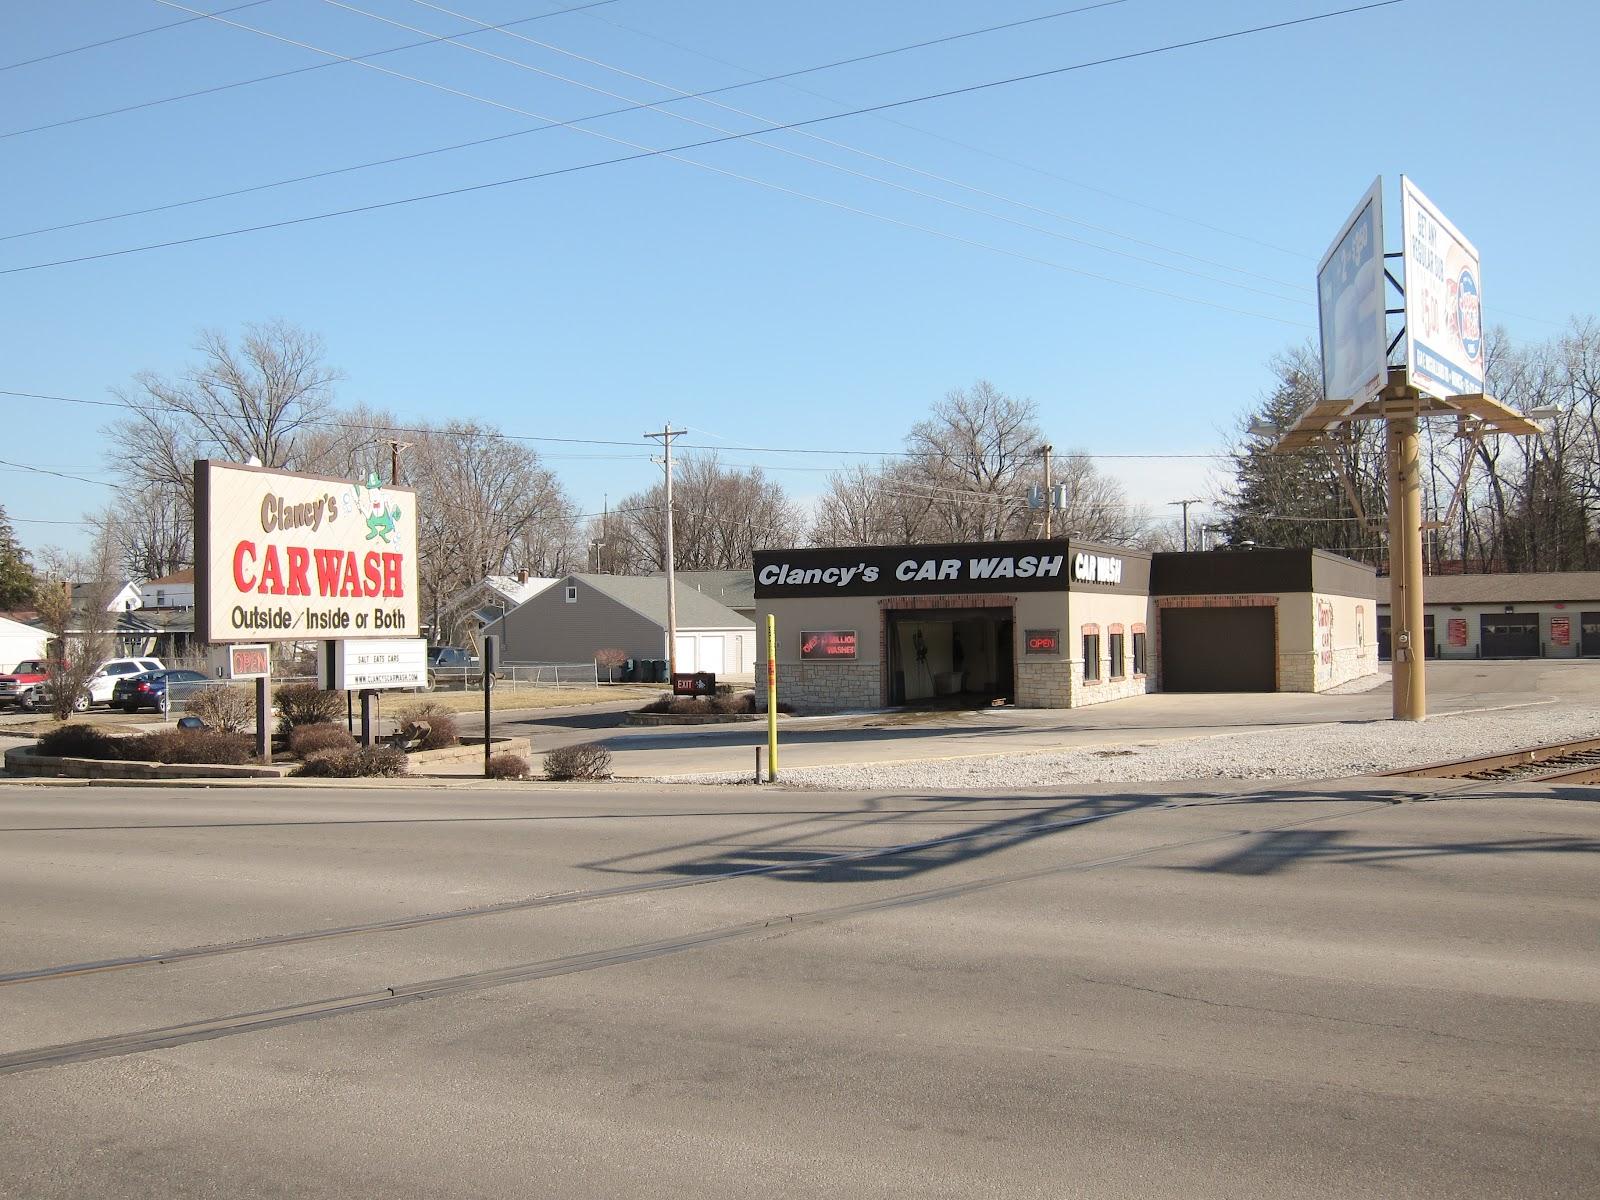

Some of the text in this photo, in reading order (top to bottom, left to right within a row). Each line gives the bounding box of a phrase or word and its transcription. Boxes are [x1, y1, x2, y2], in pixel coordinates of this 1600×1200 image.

[261, 493, 338, 533] Clancy's
[758, 555, 1064, 587] Clancy's CAR WASH
[1074, 552, 1121, 584] CAR WASH
[355, 614, 369, 629] or
[374, 608, 405, 629] Both
[1029, 638, 1055, 649] OPEN
[234, 651, 267, 673] OPEN
[373, 655, 385, 663] EATS
[677, 680, 692, 688] EXIT
